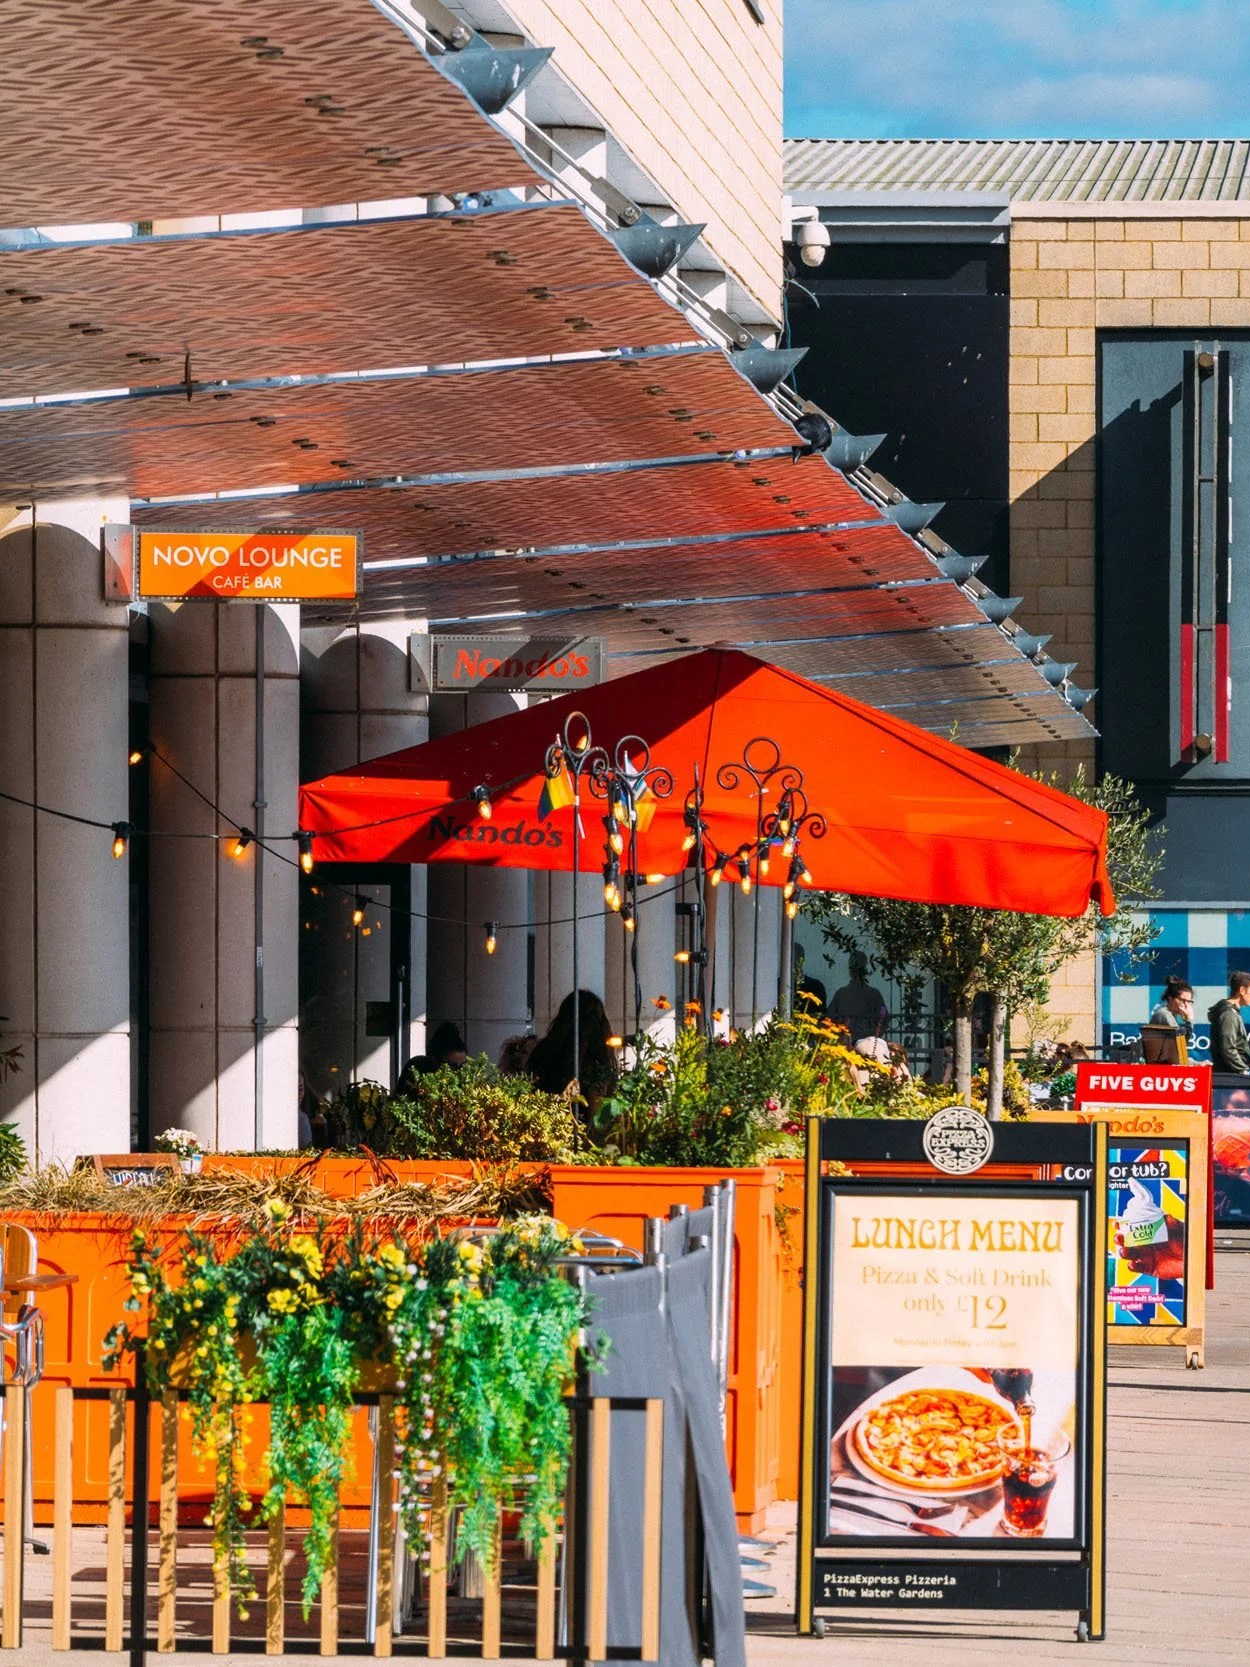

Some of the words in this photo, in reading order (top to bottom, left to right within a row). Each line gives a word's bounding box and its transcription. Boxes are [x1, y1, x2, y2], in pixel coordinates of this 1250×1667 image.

[153, 546, 230, 567] NOVO
[239, 547, 343, 568] LOUNGE
[212, 573, 250, 589] CAFÉ
[254, 576, 282, 589] BAR
[453, 648, 590, 680] Nando's
[427, 815, 562, 847] Nando's
[1089, 1075, 1134, 1091] FIVE
[1140, 1077, 1197, 1092] GUYS
[1076, 1114, 1165, 1134] Nndo's
[941, 1129, 976, 1139] PIZZA
[931, 1138, 986, 1148] EXPRESS
[1109, 1166, 1128, 1178] or
[1130, 1163, 1168, 1178] tub?
[851, 1217, 961, 1250] LUNCH
[968, 1219, 1065, 1253] MENU
[1129, 1223, 1154, 1233] Extra
[1132, 1230, 1153, 1239] Cold
[862, 1265, 918, 1285] Pizza
[924, 1267, 940, 1286] &
[945, 1267, 986, 1287] Soft
[993, 1268, 1053, 1288] Drink
[904, 1293, 946, 1316] only
[823, 1573, 900, 1586] PizzaExpress
[905, 1574, 957, 1586] Pizzeria
[823, 1587, 831, 1598] 1
[836, 1587, 857, 1598] The
[860, 1588, 894, 1598] Water
[898, 1588, 944, 1599] Gardens
